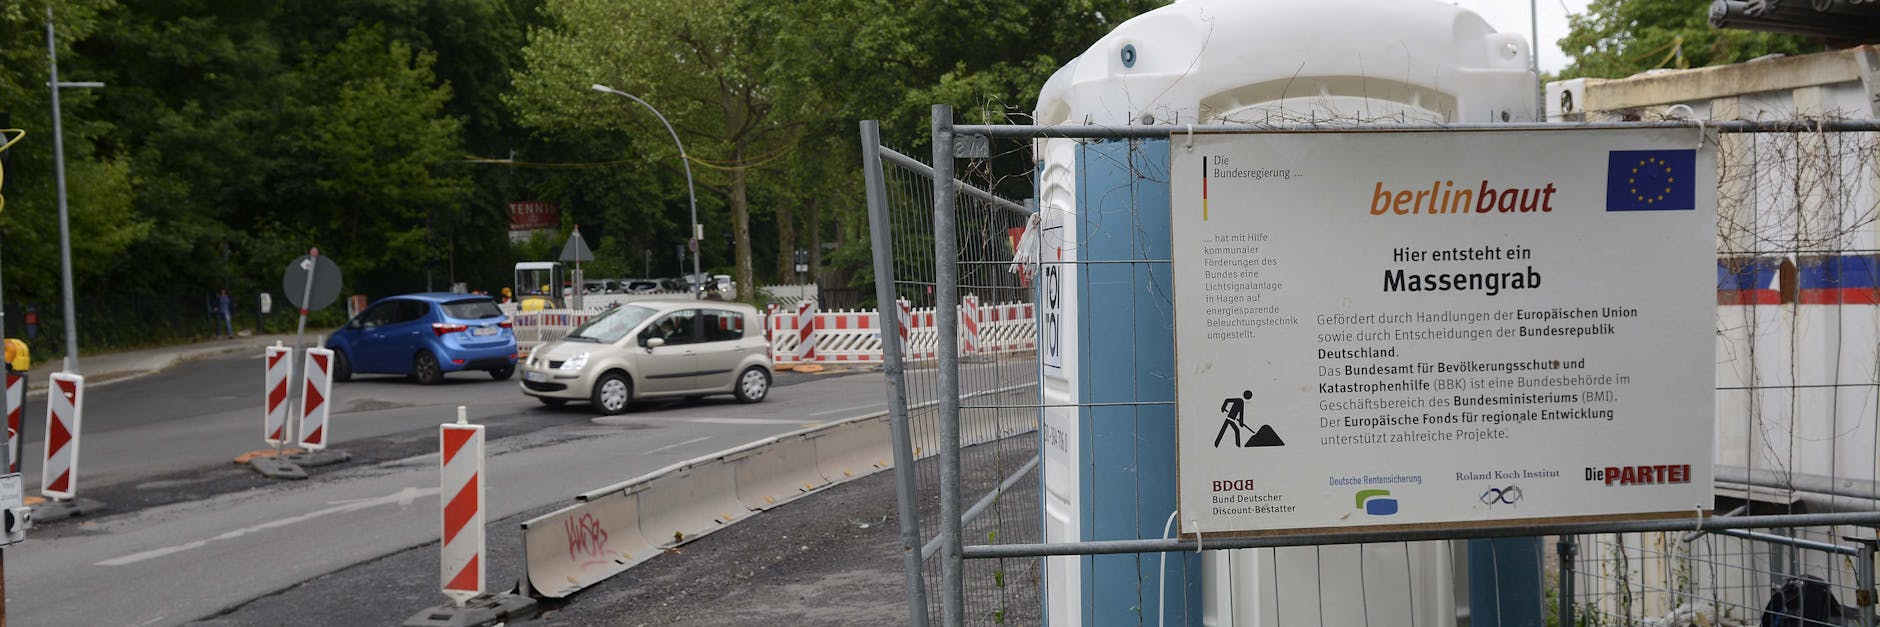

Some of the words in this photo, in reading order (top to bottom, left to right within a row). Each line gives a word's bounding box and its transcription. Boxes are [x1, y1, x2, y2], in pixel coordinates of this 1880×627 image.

[1214, 155, 1229, 166] Die
[1214, 168, 1290, 179] Bundesregierung
[1215, 234, 1229, 243] hat
[1231, 233, 1245, 242] mit
[1247, 233, 1268, 242] Hilfe
[1204, 245, 1258, 254] kommunaler
[1393, 247, 1427, 263] Hier
[1432, 246, 1501, 262] entsteht
[1506, 245, 1531, 260] ein
[1204, 257, 1259, 268] Förderungen
[1261, 257, 1277, 266] des
[1205, 270, 1238, 278] Bundes
[1240, 270, 1259, 278] eine
[1205, 281, 1283, 292] Lichtsignalanlage
[1383, 266, 1542, 297] Massengrab
[1206, 294, 1214, 303] in
[1216, 294, 1244, 305] Hagen
[1246, 293, 1261, 303] auf
[1206, 305, 1281, 315] energiesparende
[1317, 314, 1375, 325] Gefördert
[1378, 313, 1412, 325] durch
[1416, 311, 1490, 325] Handlungen
[1493, 310, 1513, 321] der
[1517, 308, 1598, 322] Europäischen
[1602, 306, 1638, 319] Union
[1207, 316, 1298, 328] Beleuchtungstechnik
[1207, 330, 1255, 341] umgestellt.
[1317, 332, 1353, 342] sowie
[1356, 329, 1390, 342] durch
[1395, 328, 1492, 342] Entscheidungen
[1496, 327, 1516, 338] der
[1519, 324, 1615, 339] Bundesrepublik
[1318, 346, 1399, 359] Deutschland.
[1319, 365, 1341, 377] Das
[1345, 363, 1414, 376] Bundesamt
[1417, 362, 1434, 374] für
[1563, 357, 1585, 369] und
[1319, 380, 1430, 394] Katastrophenhilfe
[1433, 378, 1466, 391] (BBK)
[1470, 377, 1485, 389] ist
[1488, 378, 1513, 388] eine
[1517, 374, 1612, 388] Bundesbehörde
[1616, 373, 1630, 385] im
[1319, 397, 1425, 411] Geschäftsbereich
[1429, 396, 1450, 408] des
[1454, 392, 1578, 406] Bundesministeriums
[1581, 390, 1618, 403] (BMI).
[1320, 416, 1343, 428] Der
[1344, 413, 1419, 427] Europäische
[1422, 412, 1458, 424] Fonds
[1462, 412, 1478, 423] für
[1481, 409, 1537, 425] regionale
[1541, 408, 1614, 420] Entwicklung
[1320, 433, 1386, 446] unterstützt
[1390, 430, 1452, 443] zahlreiche
[1456, 429, 1509, 442] Projekte.
[1329, 475, 1361, 486] Deutsche
[1363, 474, 1422, 485] Rentensicherung
[1456, 471, 1492, 482] Roland
[1495, 470, 1520, 480] Koch
[1523, 469, 1560, 479] Institut
[1212, 494, 1235, 504] Bund
[1237, 493, 1282, 503] Deutscher
[1212, 504, 1296, 516] Discount-Bestatter
